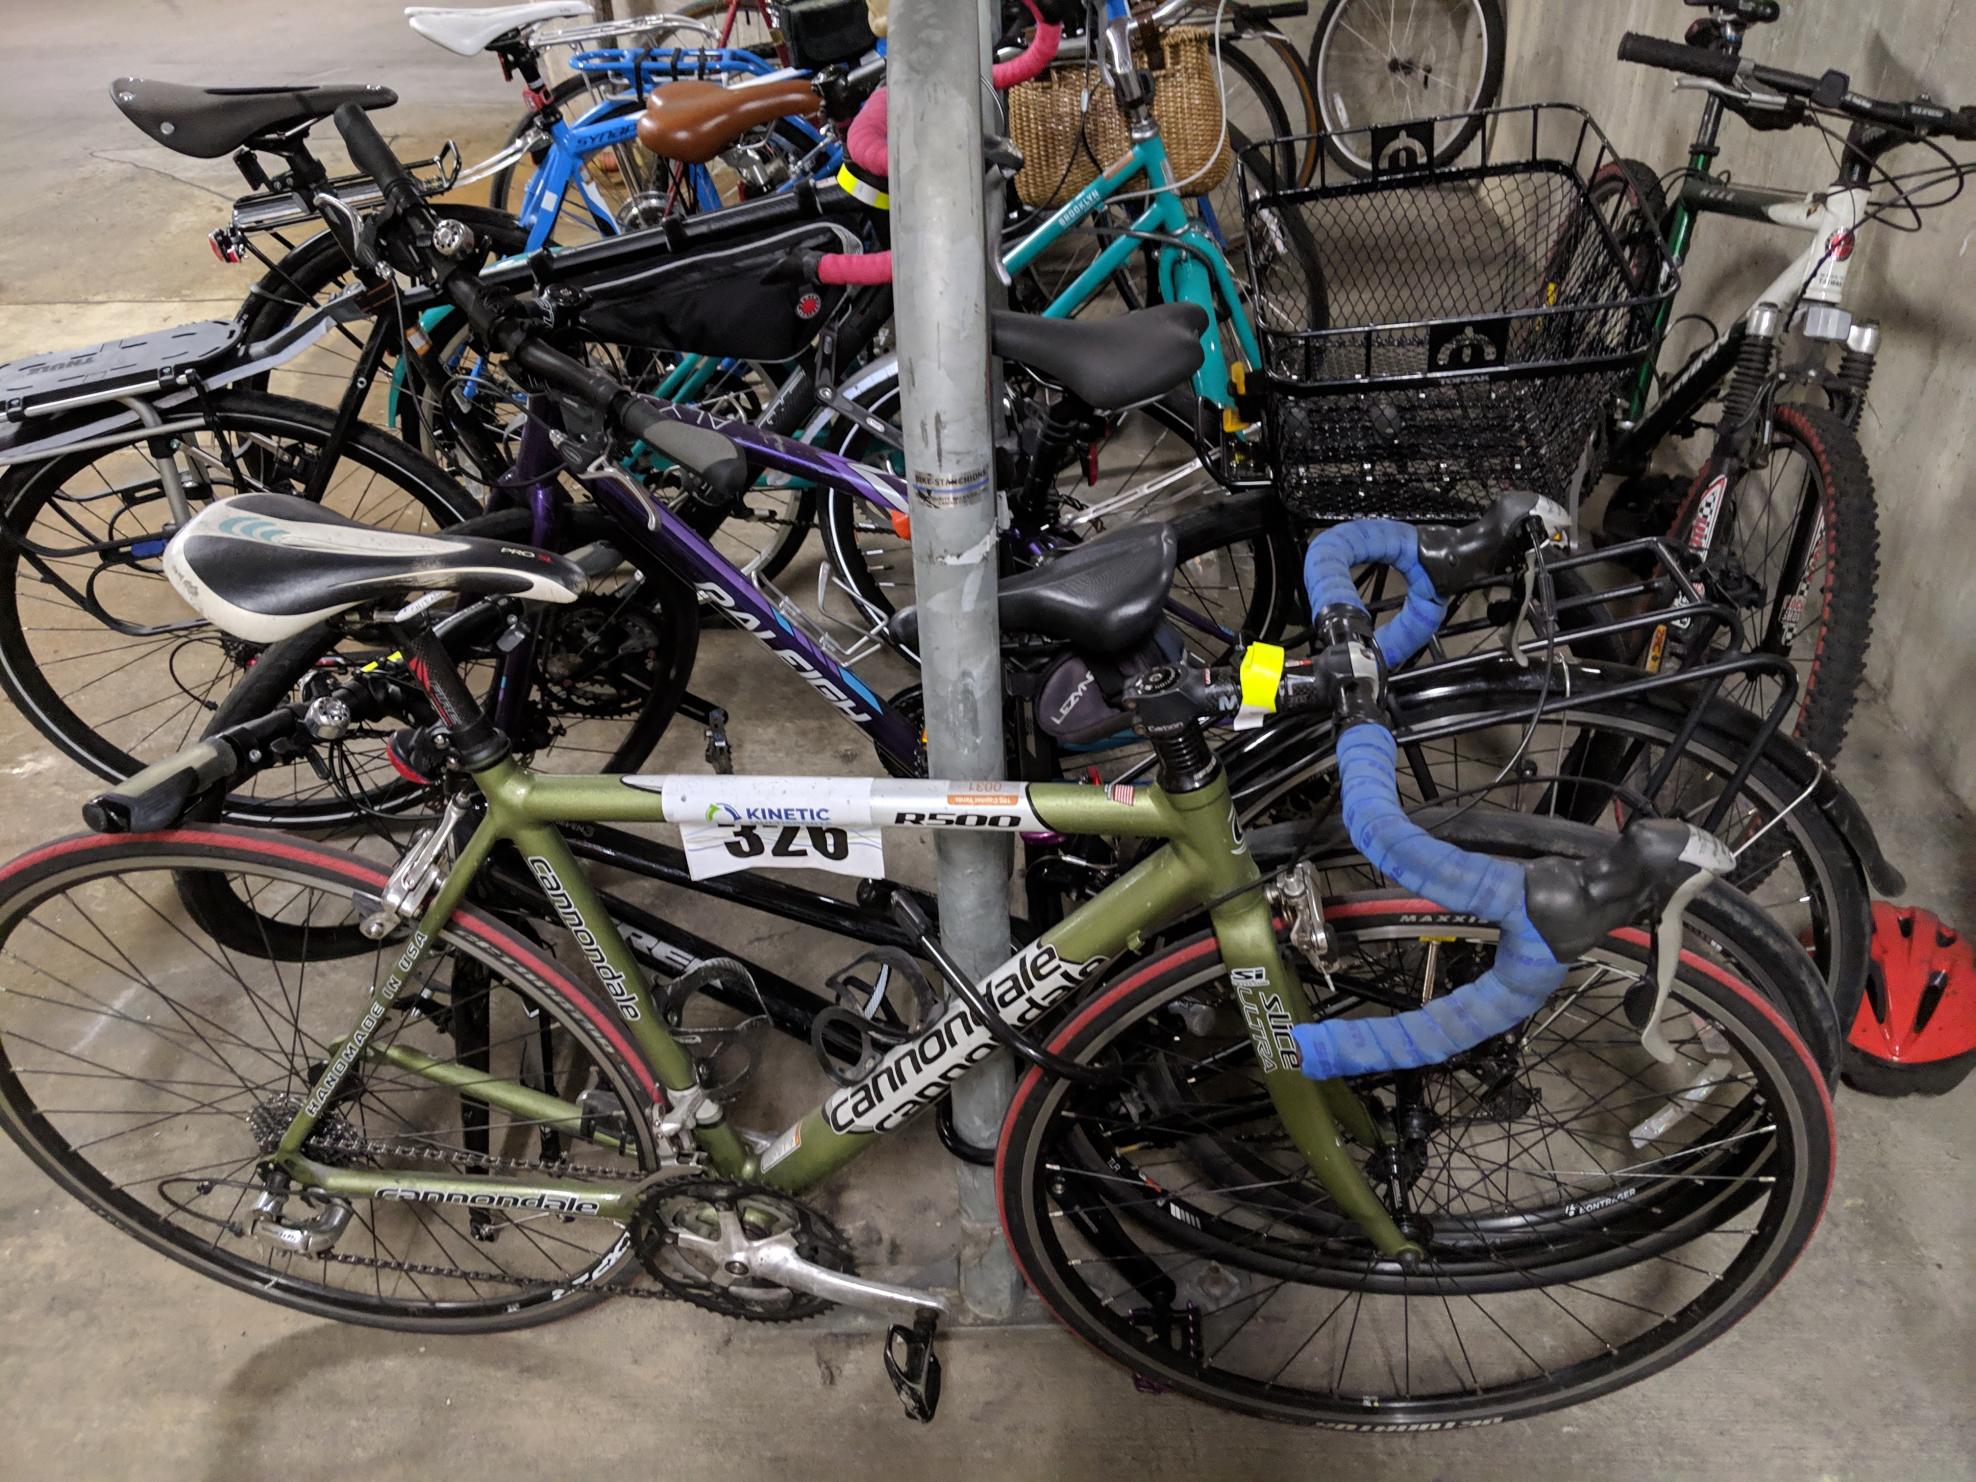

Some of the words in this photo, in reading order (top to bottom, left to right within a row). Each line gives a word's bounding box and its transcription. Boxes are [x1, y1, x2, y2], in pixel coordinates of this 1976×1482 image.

[1058, 188, 1100, 227] BROOKLYN
[500, 546, 536, 558] PRO
[694, 581, 873, 723] RALEIGH
[745, 806, 831, 822] KINETIC
[894, 812, 1021, 828] R500
[717, 822, 849, 861] 326
[527, 855, 641, 1021] cannondale
[304, 1001, 386, 1118] HANDMADE
[381, 973, 402, 1001] IN
[397, 930, 428, 973] USA
[1236, 985, 1278, 1074] ULTRA
[375, 1185, 601, 1216] cannondale
